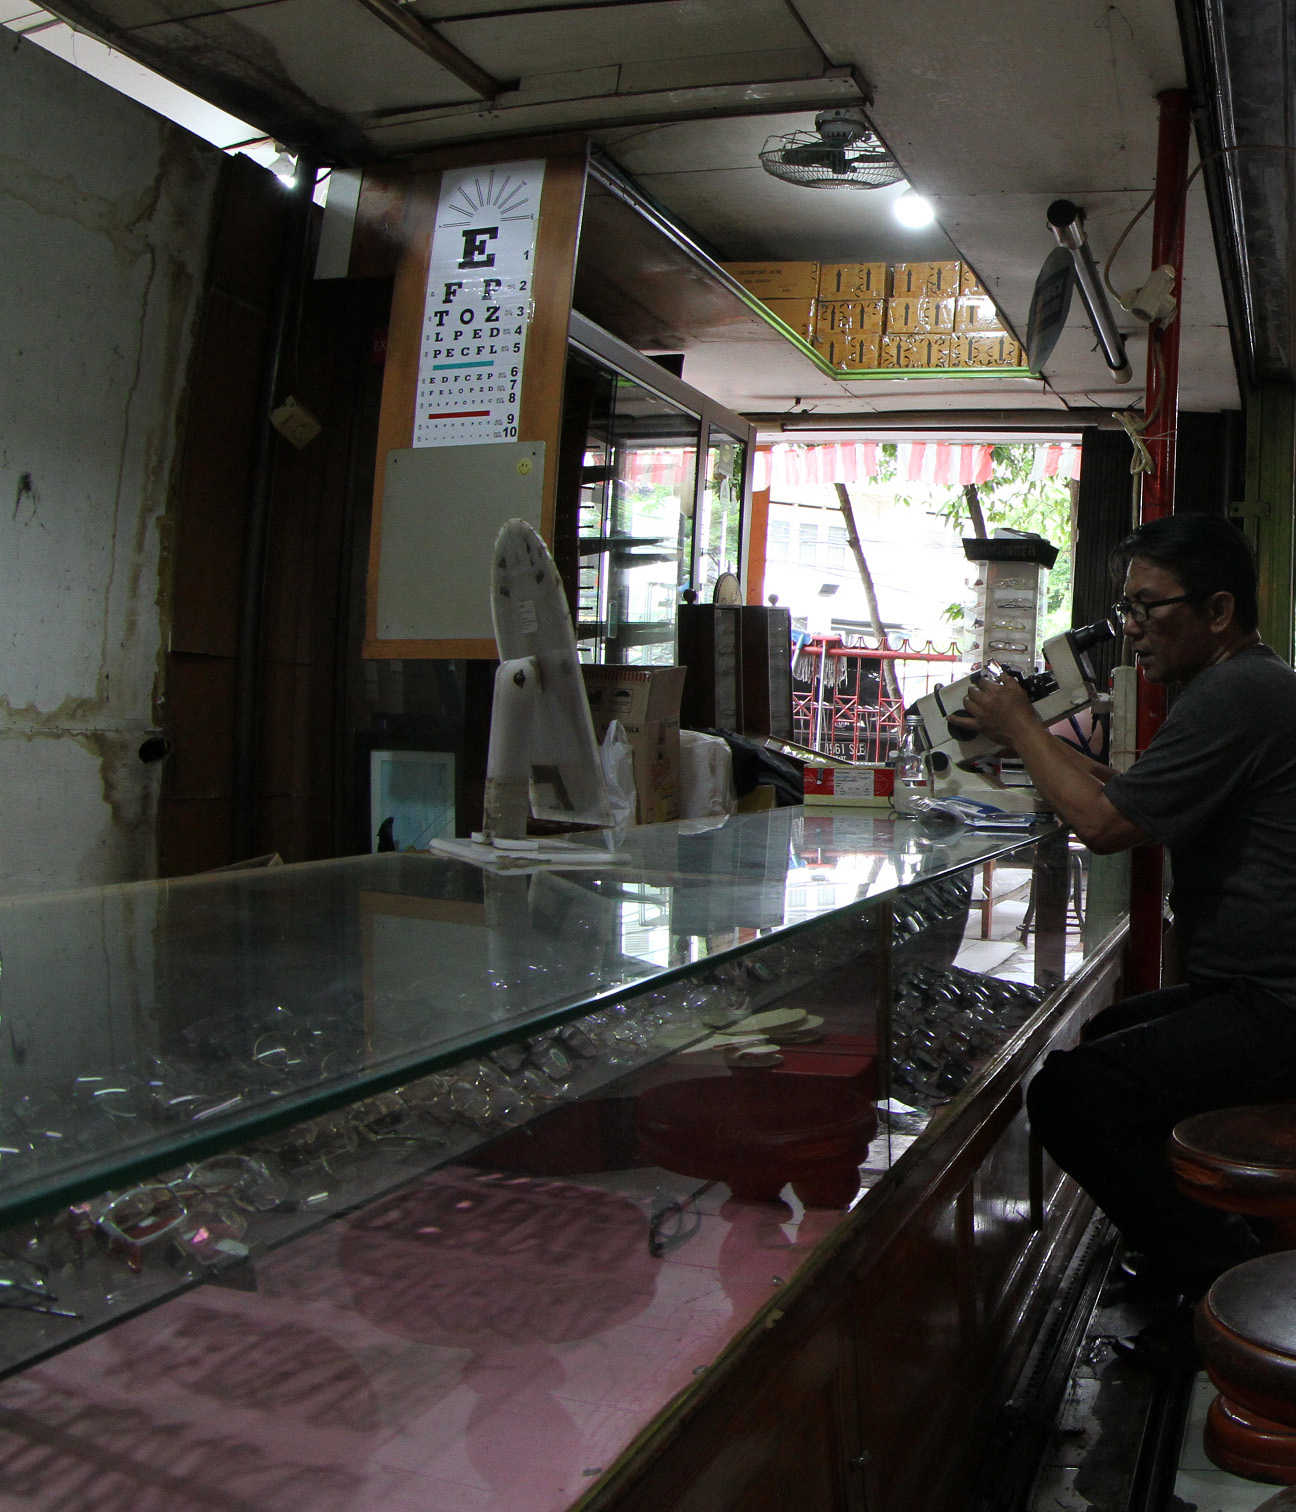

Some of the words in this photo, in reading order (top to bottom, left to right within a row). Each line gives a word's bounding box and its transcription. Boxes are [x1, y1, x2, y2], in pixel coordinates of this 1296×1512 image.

[457, 226, 499, 270] E
[523, 250, 529, 261] 1
[442, 281, 464, 304] F
[481, 278, 502, 301] P
[519, 280, 527, 291] 2
[433, 310, 450, 327] T
[459, 308, 475, 325] O
[484, 305, 501, 323] Z
[516, 306, 525, 317] 3
[434, 332, 444, 343] L
[453, 330, 463, 341] P
[471, 328, 483, 340] E
[488, 327, 500, 338] D
[514, 324, 522, 336] 4
[433, 349, 442, 359] P
[445, 348, 455, 358] E
[460, 347, 470, 357] C
[475, 345, 485, 356] F
[489, 345, 498, 355] L
[512, 342, 521, 353] 5
[510, 366, 519, 378] 6
[508, 392, 516, 404] 8
[507, 413, 515, 425] 9
[502, 426, 517, 438] 10
